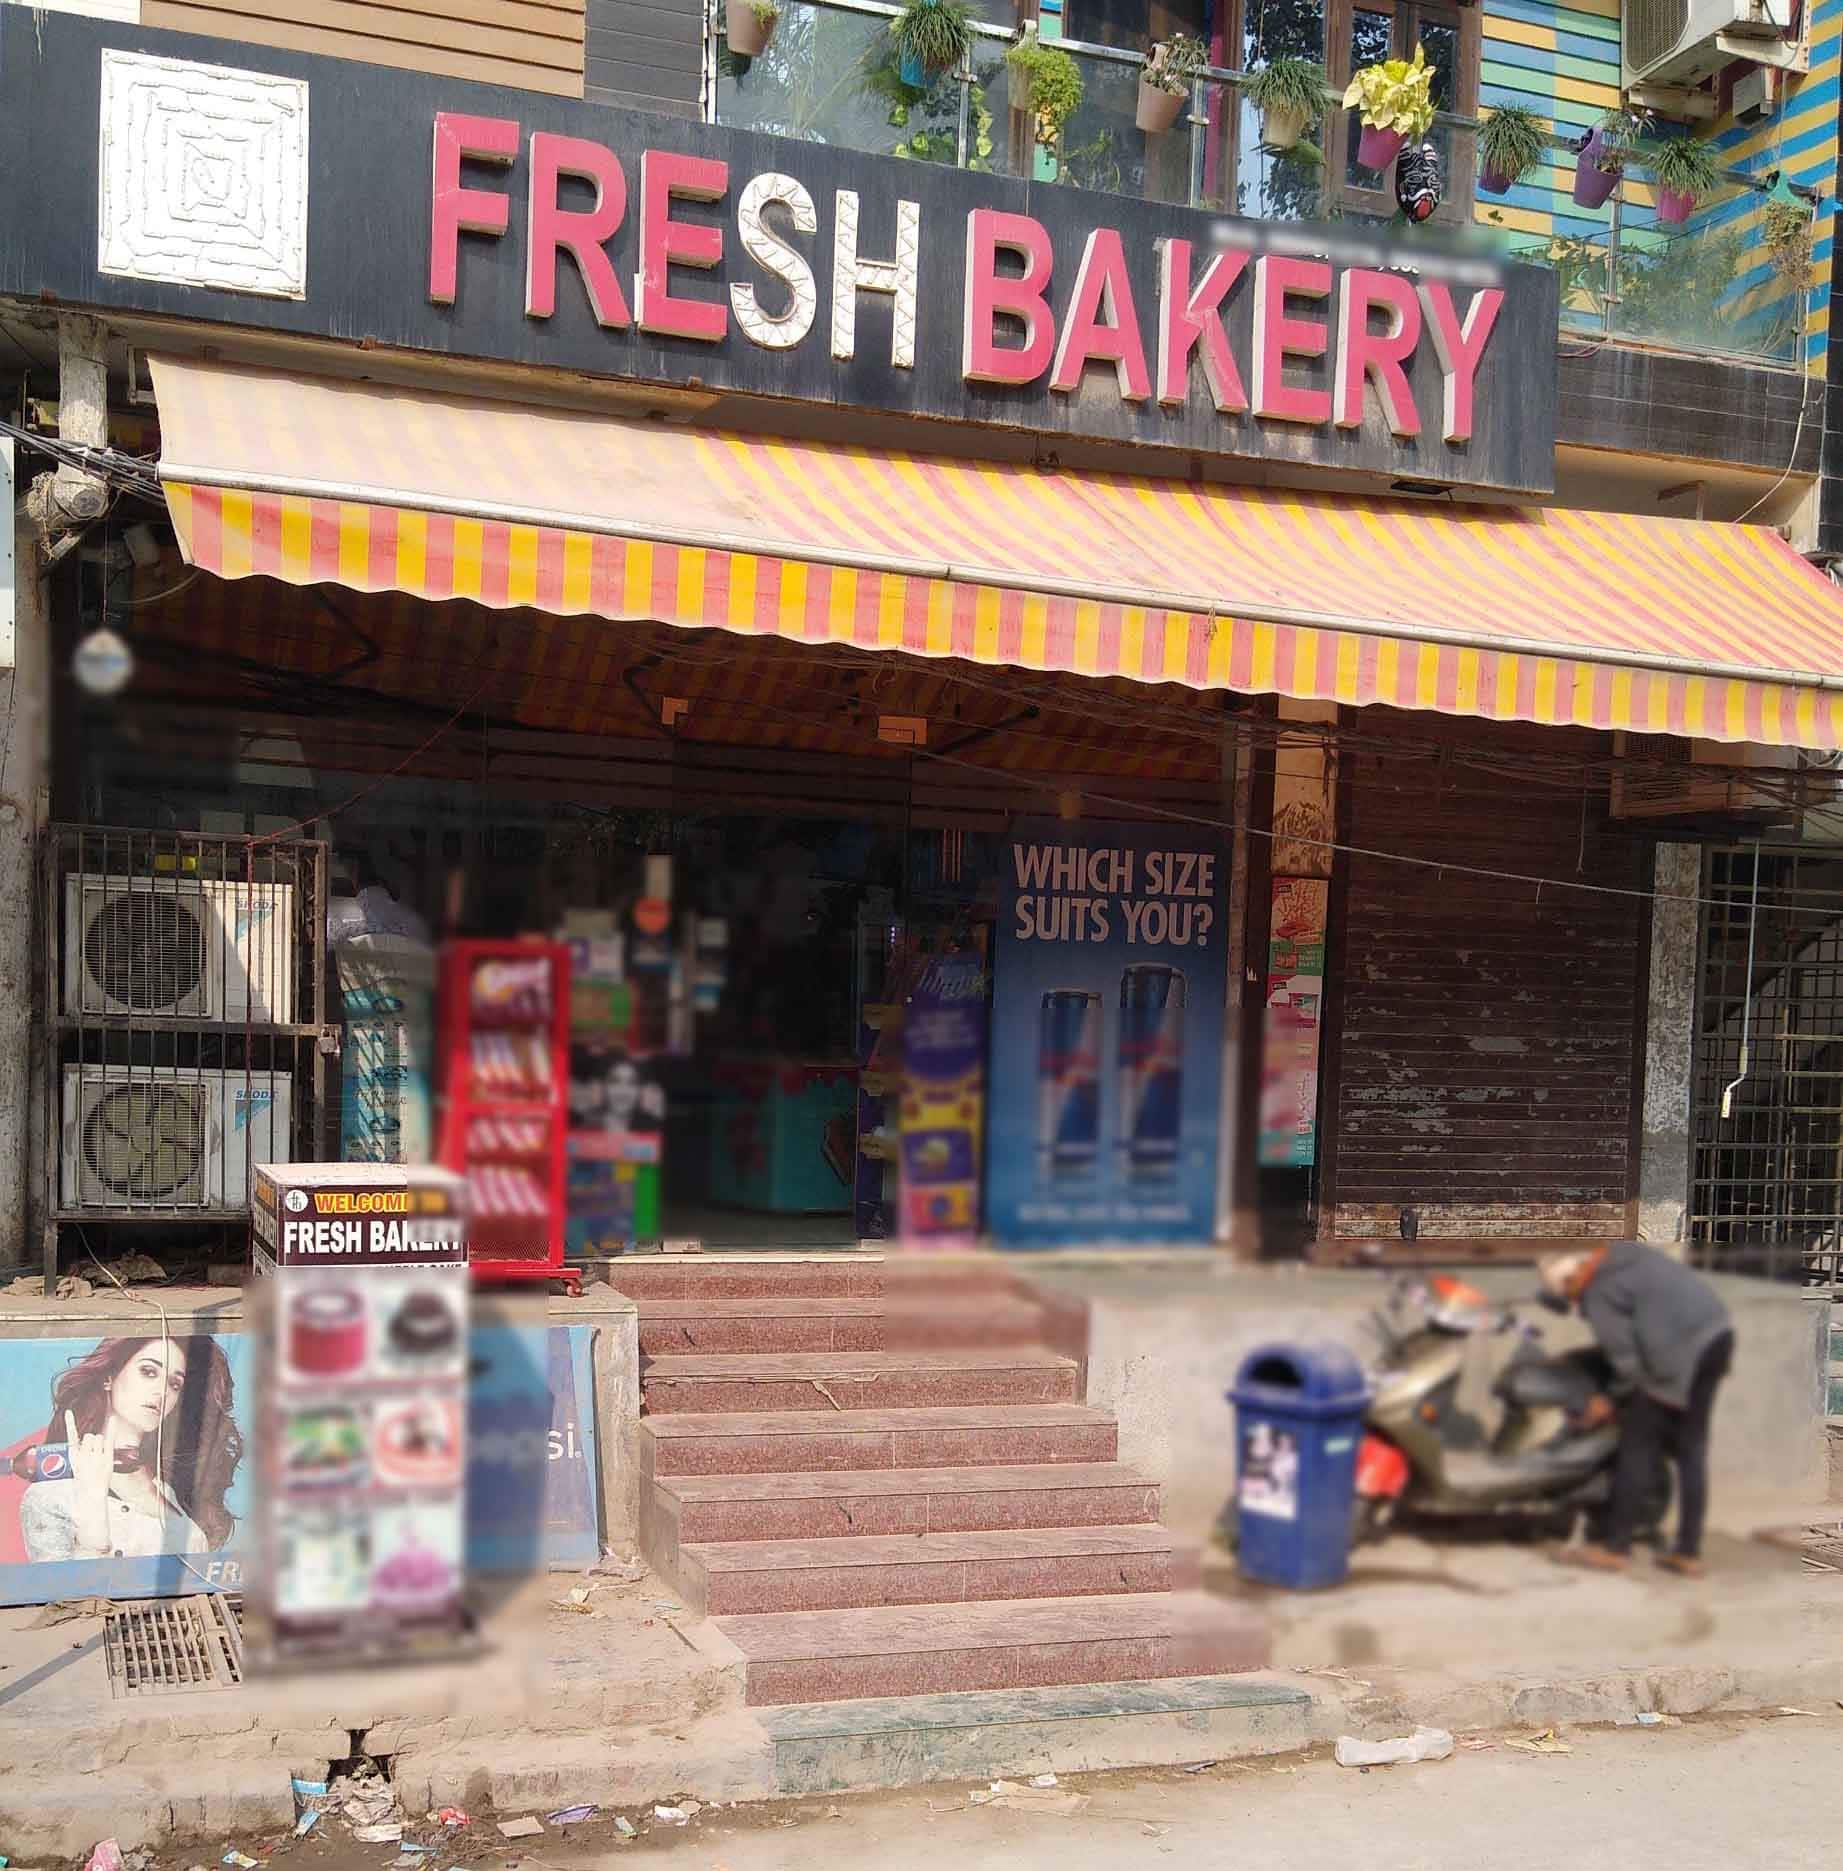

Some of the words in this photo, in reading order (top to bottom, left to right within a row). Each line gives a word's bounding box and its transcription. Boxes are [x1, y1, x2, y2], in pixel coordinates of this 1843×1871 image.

[430, 112, 921, 368] FRESH
[962, 208, 1505, 443] BAKERY
[1014, 844, 1134, 894] WHICH
[1145, 851, 1215, 896] SIZE
[1015, 895, 1109, 943] SUITS
[1120, 899, 1214, 946] YOU?
[284, 1221, 362, 1254] FRESH
[369, 1220, 461, 1254] BAK
